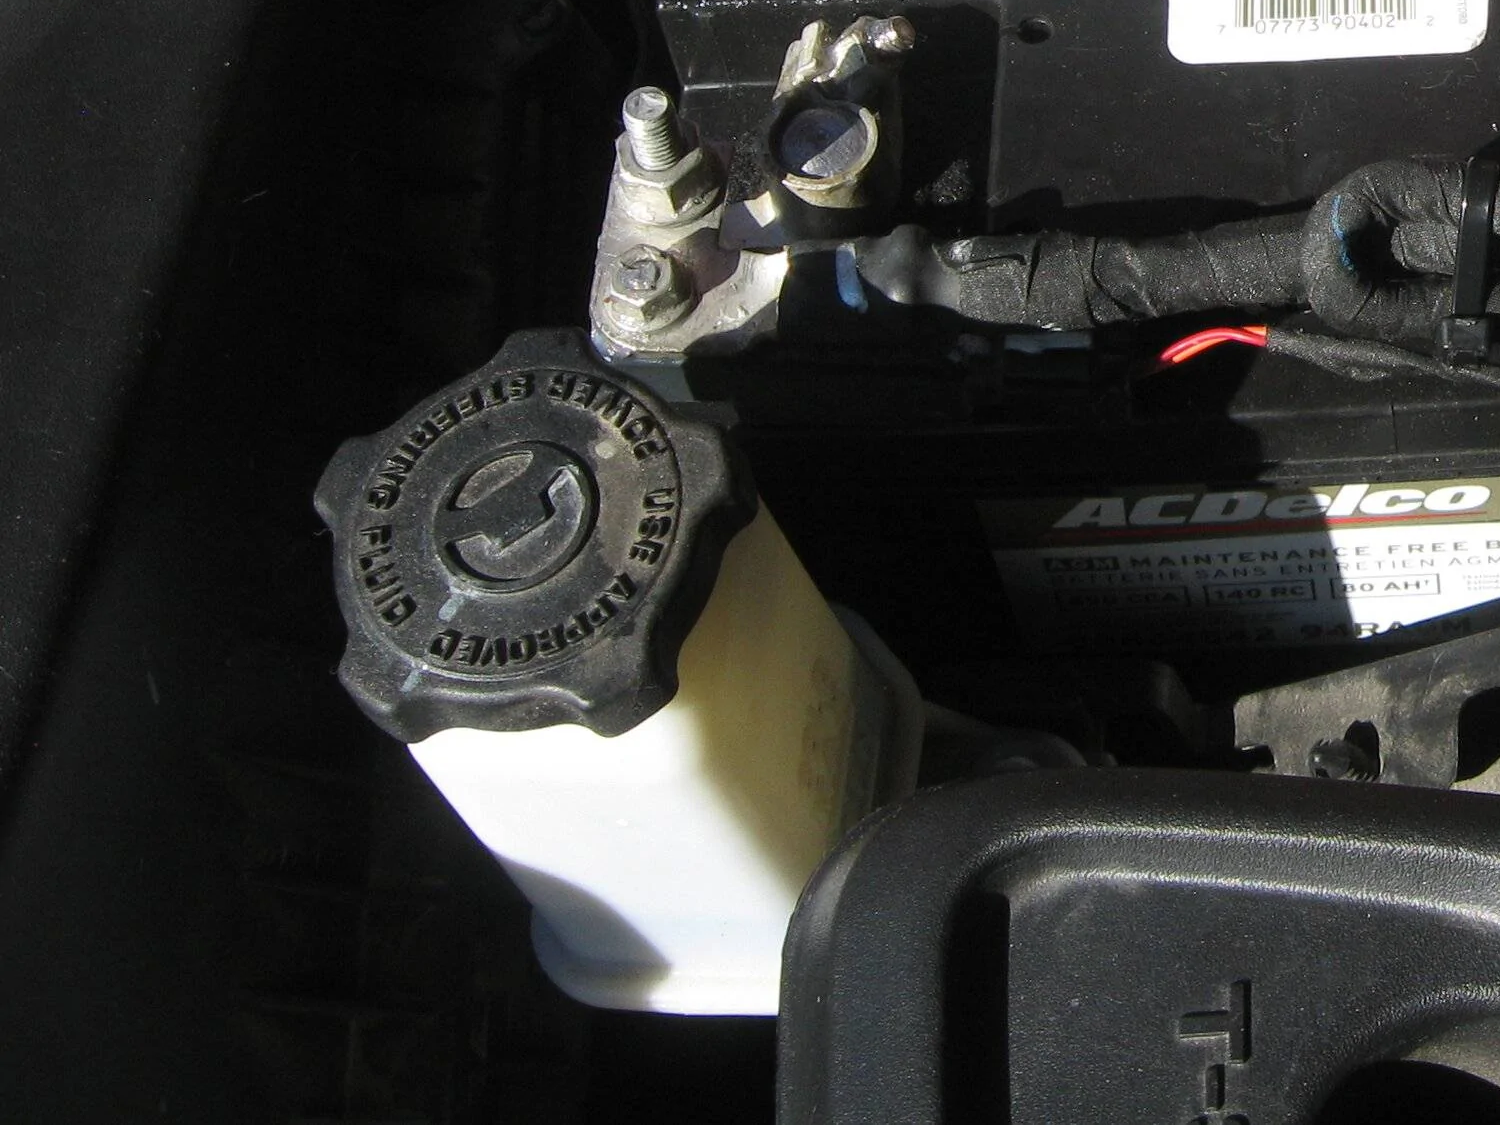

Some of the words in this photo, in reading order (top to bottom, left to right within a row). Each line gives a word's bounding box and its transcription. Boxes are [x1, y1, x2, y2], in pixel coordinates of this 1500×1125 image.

[1255, 15, 1319, 33] 07773
[1332, 12, 1395, 30] 90402
[548, 373, 672, 461] POWER
[367, 373, 536, 512] STEERING
[629, 487, 676, 566] USE
[1053, 483, 1491, 529] ACDelco
[357, 524, 418, 627] FLUID
[1130, 544, 1371, 567] MAINTENANCE
[1388, 539, 1477, 554] FREE
[1197, 564, 1267, 578] SANS
[1280, 556, 1440, 574] ENTRETIEN
[1270, 584, 1307, 597] RC
[1341, 580, 1375, 594] 80
[428, 571, 638, 668] APPROVED
